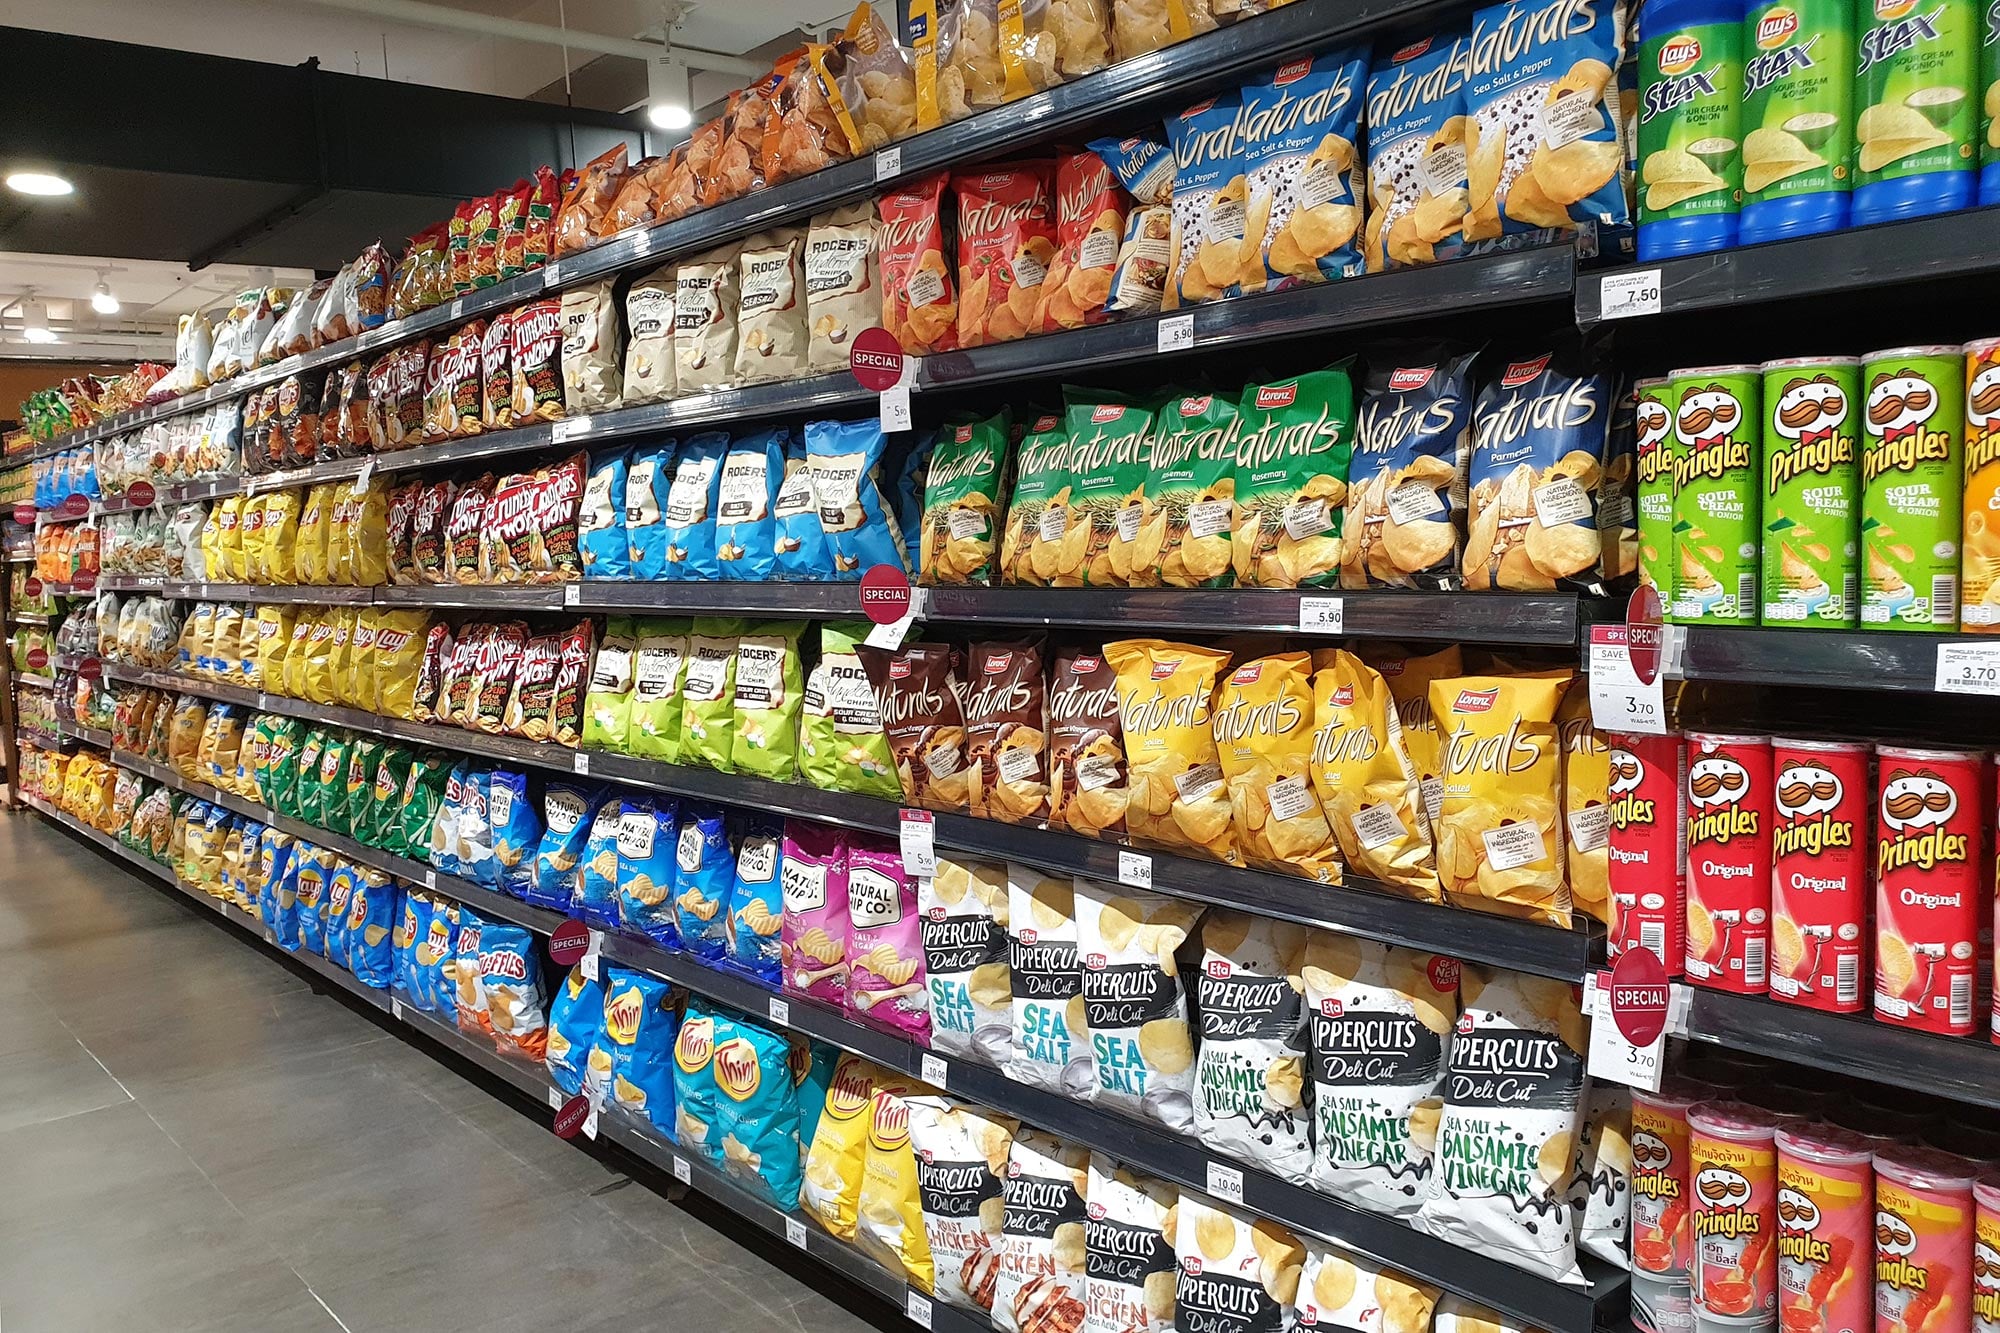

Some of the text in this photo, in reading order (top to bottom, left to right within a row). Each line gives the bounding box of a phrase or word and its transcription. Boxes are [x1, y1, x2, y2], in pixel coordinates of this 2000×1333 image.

[1758, 17, 1798, 42] Lay's
[1659, 41, 1701, 67] Lay's
[1895, 51, 1954, 67] SOUR CREAM
[1278, 60, 1309, 78] Lorenz
[1474, 56, 1553, 95] Sea Salt Pepper
[1773, 78, 1828, 93] SOUR CREAM
[1678, 104, 1728, 118] SOUR CREAM
[1381, 114, 1432, 141] Salt Pepper
[1246, 134, 1314, 161] Sea Salt Pepper
[886, 159, 900, 170] 2.29
[1195, 171, 1220, 183] Pepper
[972, 238, 988, 247] Mild
[1628, 288, 1658, 302] 7.50
[1174, 329, 1192, 340] 5.90
[855, 354, 899, 368] SPECIAL
[1394, 370, 1425, 385] Lorenz
[1508, 362, 1540, 381] Lorenz
[1260, 390, 1291, 402] Lorenz
[1096, 406, 1122, 418] Lorenz
[1491, 446, 1532, 462] Parmesan
[1771, 428, 1854, 495] Pringles
[1863, 428, 1949, 494] Pringles
[1673, 437, 1750, 497] Pringles
[1082, 476, 1114, 486] Rosemary
[1252, 470, 1286, 482] Rosemary
[1697, 491, 1737, 503] SOUR
[1802, 487, 1842, 500] SOUR
[1886, 484, 1931, 498] SOUR
[1701, 499, 1743, 512] CREAM
[1805, 497, 1848, 510] CREAM
[1888, 494, 1939, 508] CREAM
[1717, 510, 1743, 521] ONION
[1823, 508, 1848, 518] ONION
[1906, 506, 1939, 518] ONION
[865, 589, 906, 601] SPECIAL
[1319, 612, 1341, 623] 5.90
[1631, 628, 1661, 644] SPECIAL
[1602, 650, 1624, 658] SAVE
[1962, 666, 1996, 680] 3.70
[846, 699, 873, 707] CHIPS
[1458, 694, 1492, 708] Lorenz
[1625, 696, 1654, 714] 3.70
[1447, 783, 1470, 793] Salted
[1496, 826, 1527, 841] NATURAL
[1688, 805, 1758, 853] Pringles
[1773, 815, 1852, 865] Pringles
[1610, 847, 1648, 864] Original
[1879, 828, 1967, 880] Pringles
[1133, 867, 1150, 879] 5.90
[1702, 861, 1753, 879] Original
[1791, 873, 1846, 891] Original
[1900, 888, 1960, 908] Original
[930, 909, 945, 920] Eta
[553, 938, 587, 950] SPECIAL
[1019, 930, 1035, 942] Eta
[929, 950, 980, 969] Deli Cut
[1086, 956, 1105, 968] Eta
[1209, 963, 1230, 976] Eta
[1435, 962, 1459, 977] NEW
[1026, 976, 1076, 994] Deli Cut
[932, 977, 974, 1011] SEA
[1617, 989, 1665, 1006] SPECIAL
[1089, 1004, 1146, 1023] Deli Cut
[1324, 1001, 1341, 1014] Eta
[936, 1005, 975, 1033] SALT
[1022, 1002, 1070, 1041] SEA
[1205, 1014, 1261, 1034] Deli Cut
[1022, 1035, 1072, 1065] SALT
[1092, 1032, 1141, 1070] SEA
[1626, 1045, 1655, 1068] 3.70
[715, 1043, 756, 1086] Thins
[930, 1066, 945, 1080] 10.00
[1323, 1057, 1398, 1079] Deli Cut
[833, 1059, 873, 1101] Thins
[1097, 1065, 1147, 1097] SALT
[1201, 1064, 1266, 1092] BALSAMIC
[1452, 1076, 1538, 1102] Deli Cut
[1202, 1085, 1263, 1114] VINEGAR
[1322, 1095, 1363, 1111] SEA SALT
[558, 1104, 587, 1131] SPECIAL
[1319, 1106, 1409, 1141] BALSAMIC
[1447, 1116, 1490, 1134] SEA SALT
[1325, 1134, 1407, 1166] VINEGAR
[1443, 1130, 1538, 1169] BALSAMIC
[917, 1162, 983, 1193] UPPERCUTS
[1443, 1155, 1532, 1195] VINEGAR
[1218, 1177, 1241, 1194] 10.00
[950, 1196, 972, 1213] Cut
[1089, 1204, 1107, 1218] Eta
[937, 1220, 962, 1233] ROAST
[1025, 1214, 1050, 1231] Cut
[1695, 1208, 1759, 1239] Pringles
[925, 1225, 991, 1250] CHICKEN
[1087, 1253, 1142, 1279] Deli Cut
[1184, 1257, 1201, 1273] Eta
[1089, 1282, 1125, 1300] ROAST
[1177, 1273, 1260, 1314] UPPERCUTS
